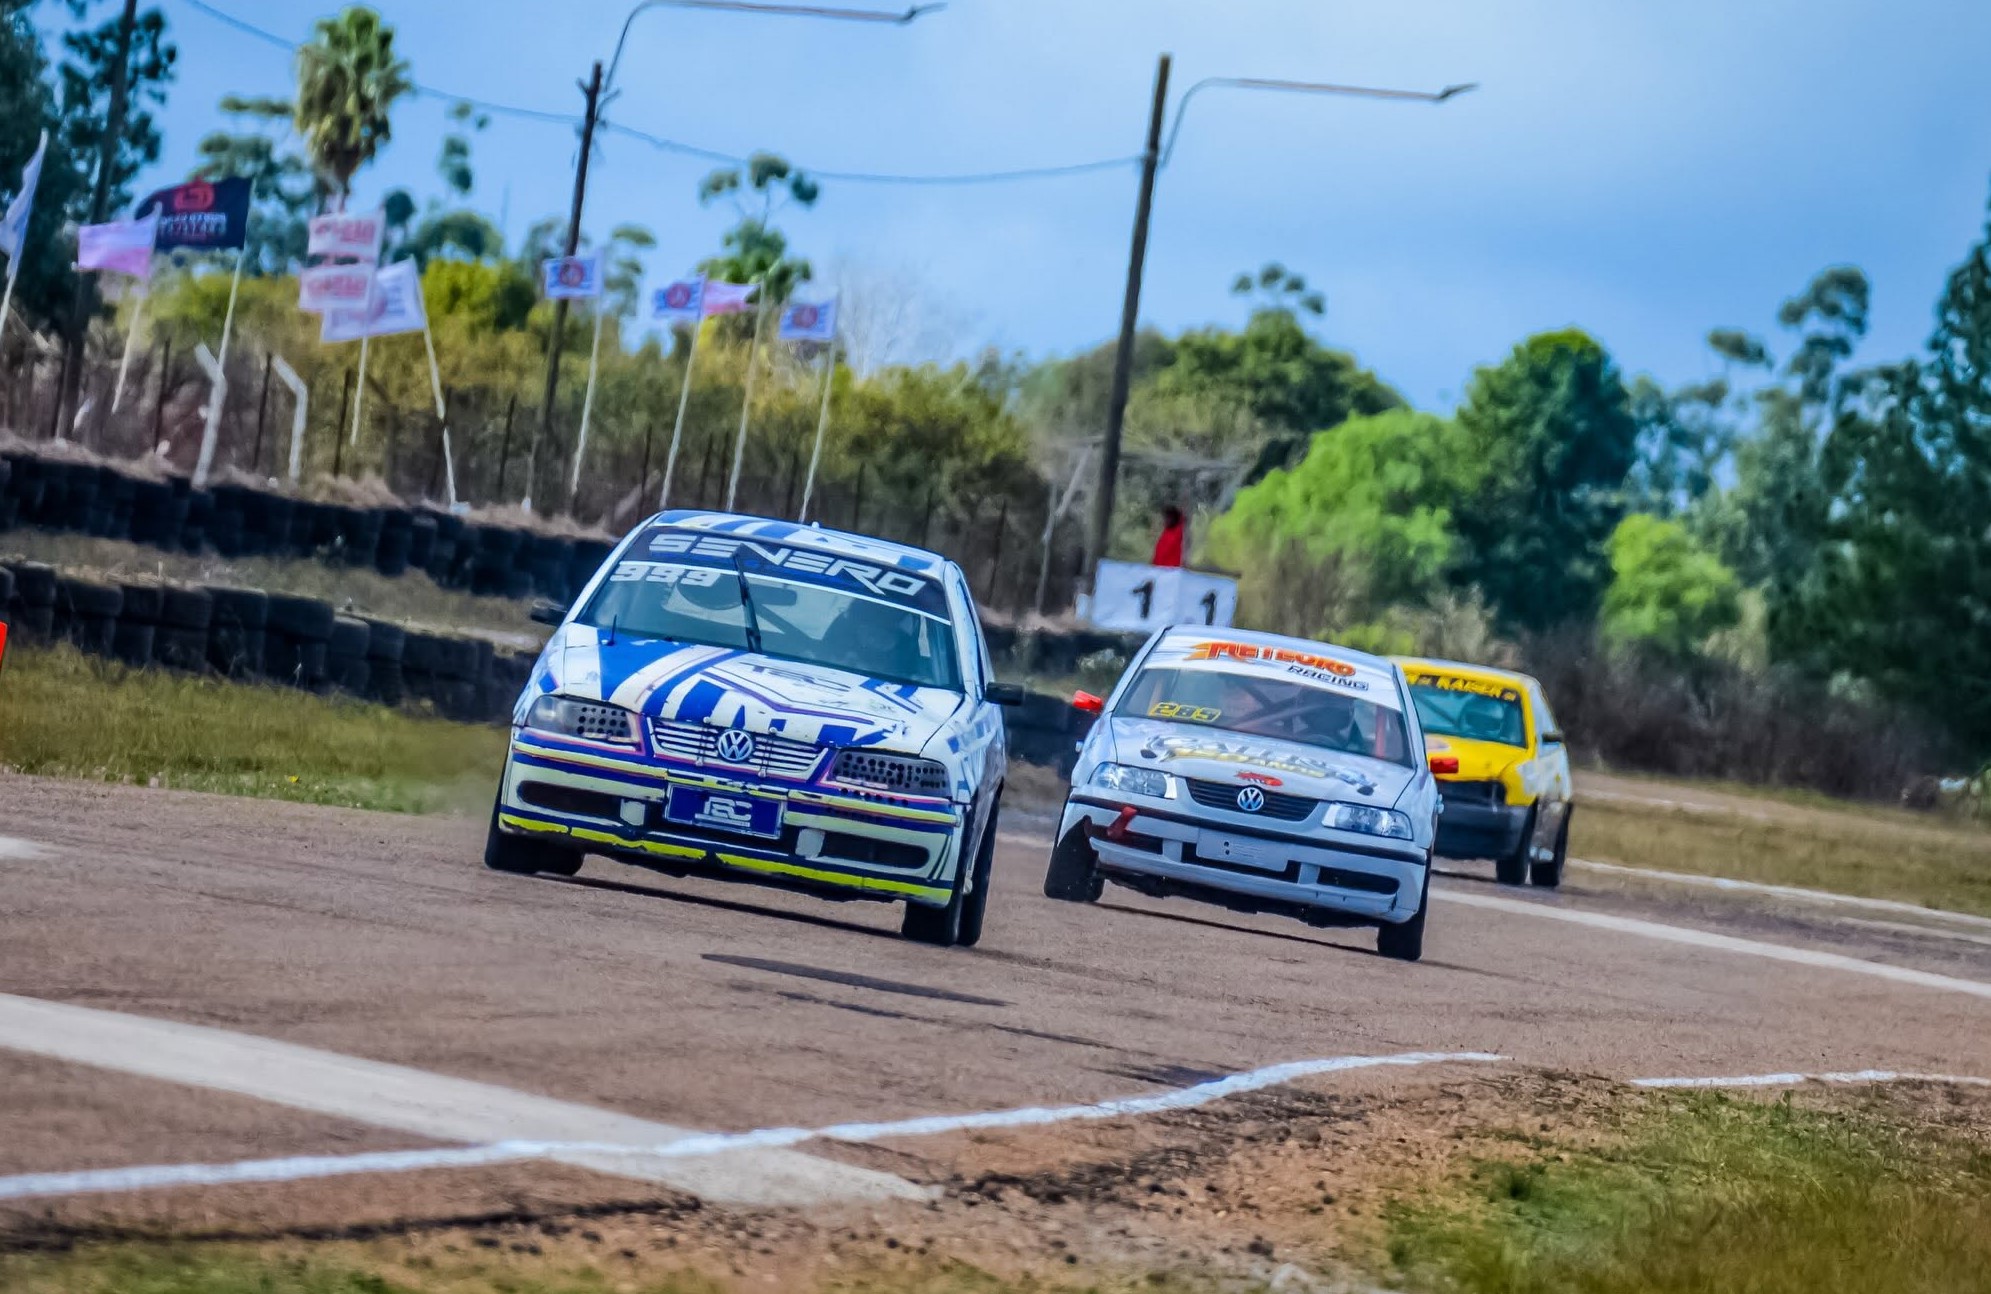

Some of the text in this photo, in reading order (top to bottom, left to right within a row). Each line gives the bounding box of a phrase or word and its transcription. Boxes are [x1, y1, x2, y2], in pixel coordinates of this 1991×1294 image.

[609, 564, 721, 588] 999
[648, 533, 927, 597] SEVERO
[1132, 580, 1154, 620] 1
[1200, 591, 1217, 626] 1
[1286, 665, 1370, 691] RACING
